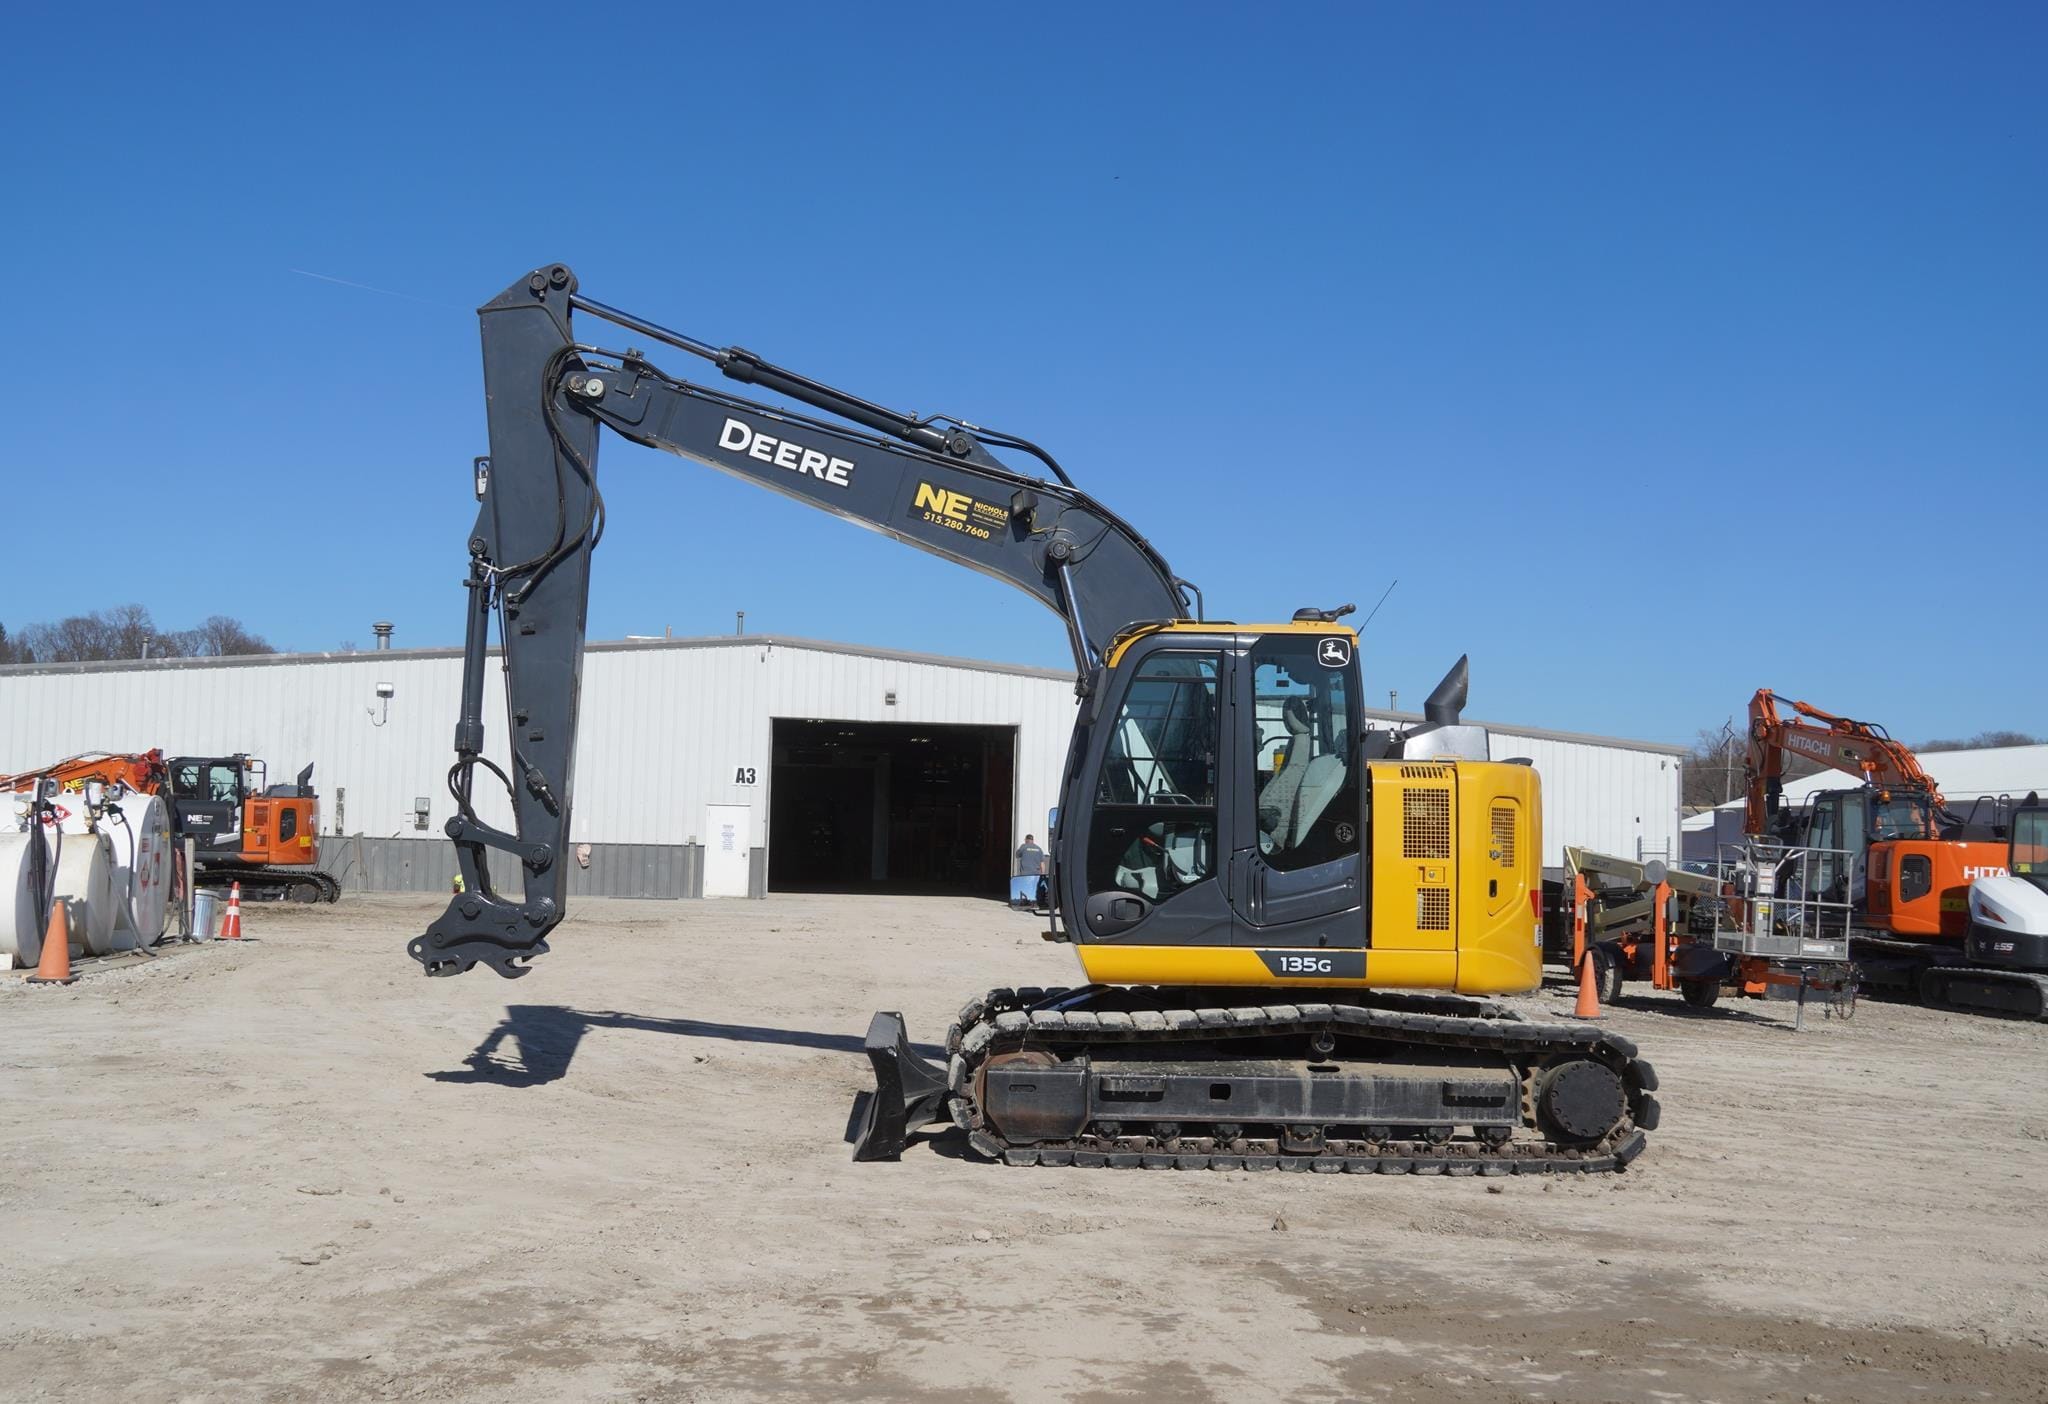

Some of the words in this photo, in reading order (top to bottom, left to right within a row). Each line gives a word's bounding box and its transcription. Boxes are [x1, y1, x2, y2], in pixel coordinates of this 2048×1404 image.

[718, 418, 855, 488] DEERE
[914, 482, 973, 521] NE
[974, 502, 1009, 517] NICHOLS
[923, 511, 990, 539] 515.280.7600
[1788, 734, 1831, 757] HITACHI
[735, 768, 757, 785] A3
[187, 814, 203, 822] NE
[1963, 866, 2011, 880] HITA
[1280, 956, 1332, 973] 135G
